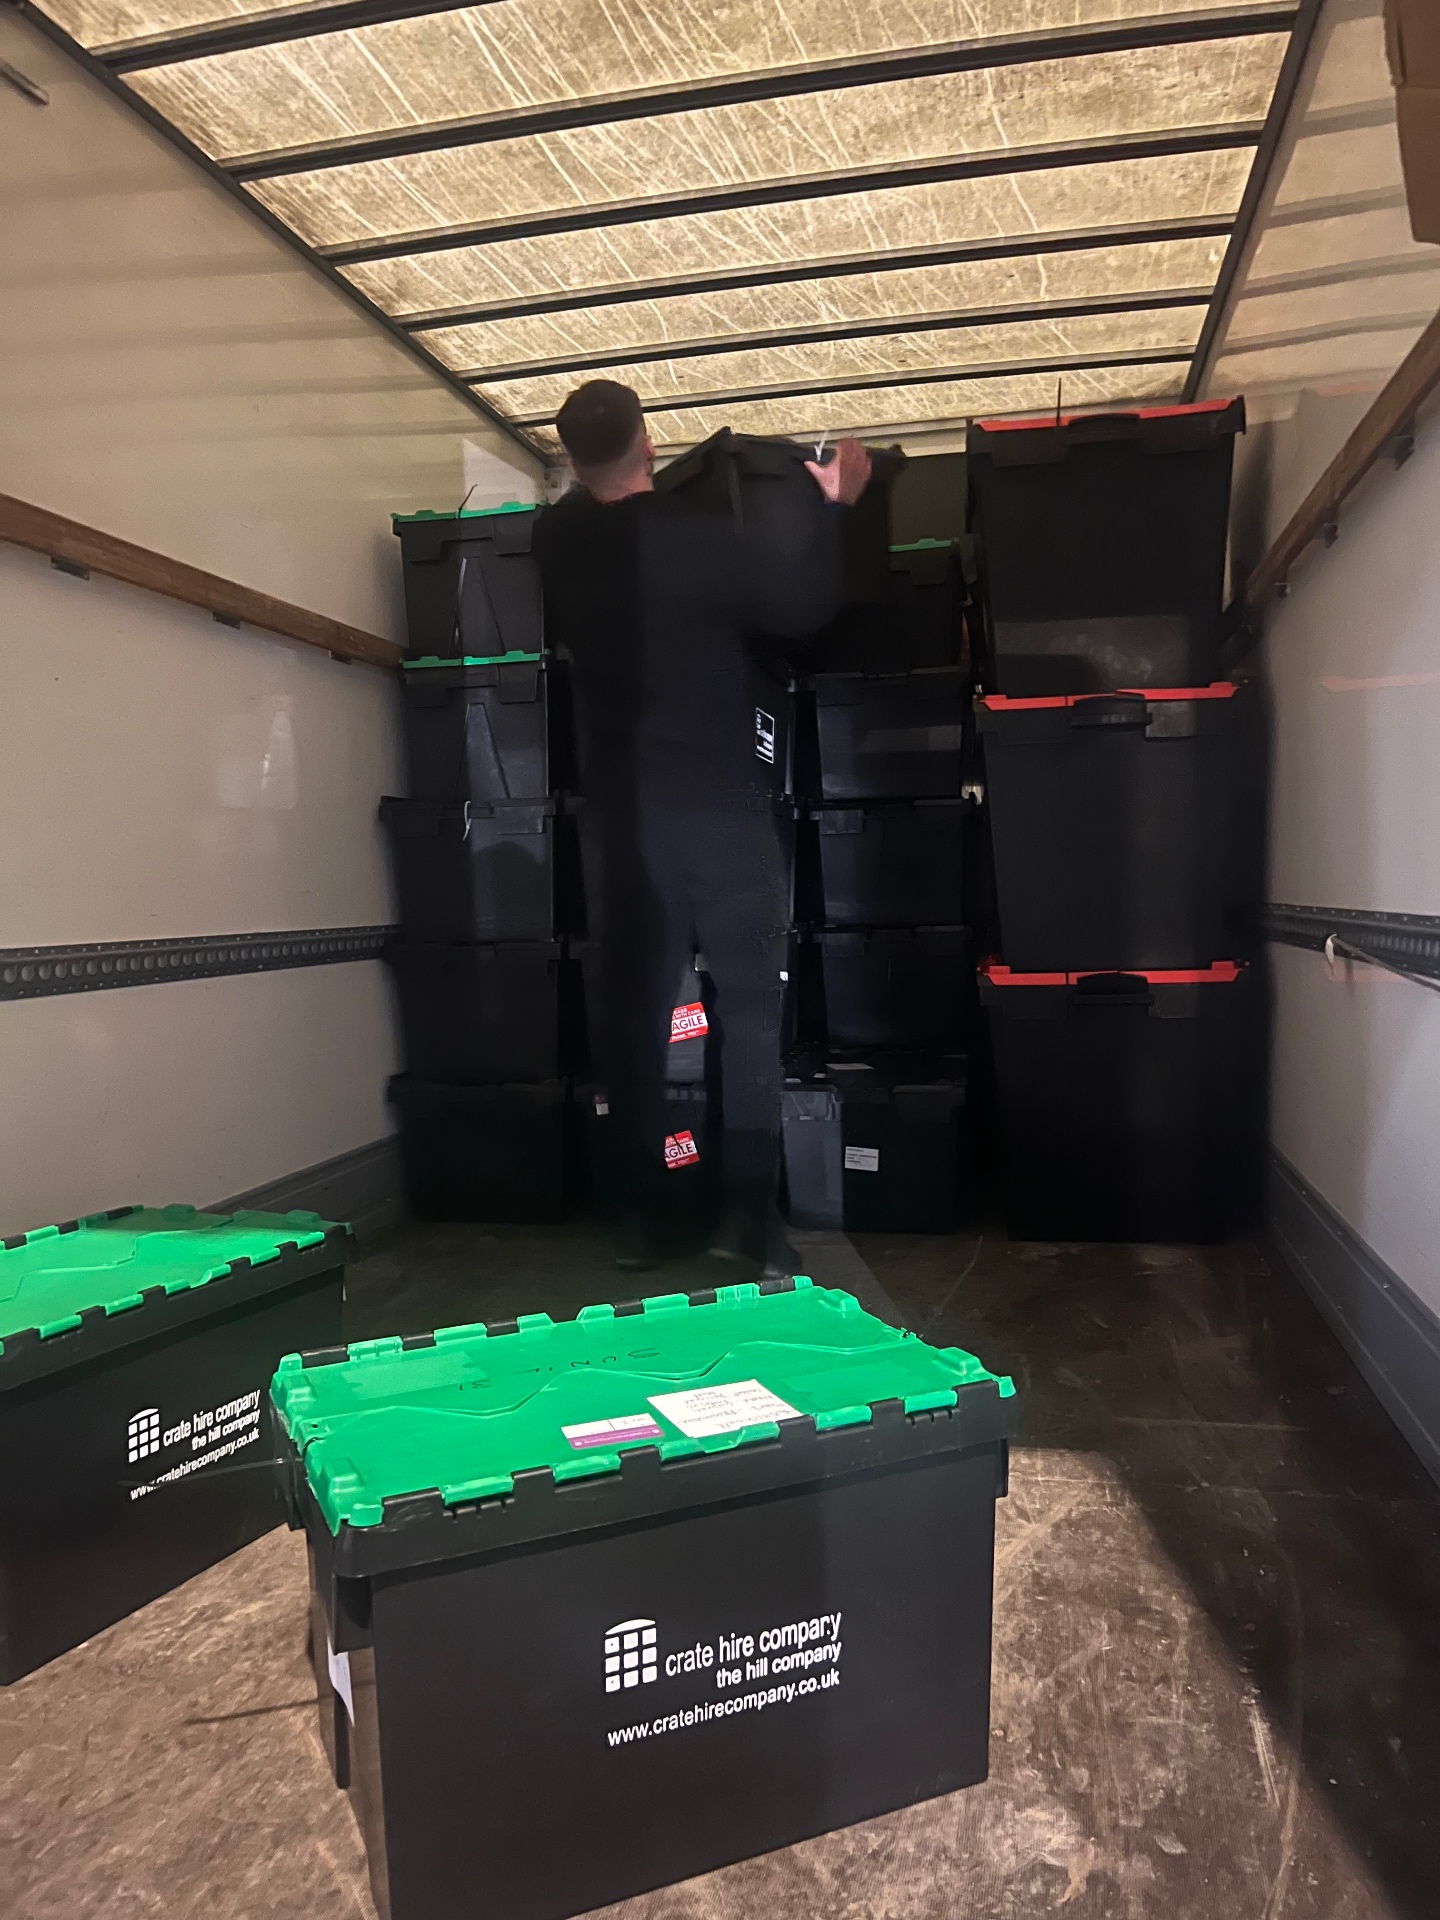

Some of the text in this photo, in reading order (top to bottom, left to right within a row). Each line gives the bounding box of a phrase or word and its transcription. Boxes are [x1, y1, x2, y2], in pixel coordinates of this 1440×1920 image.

[163, 1389, 261, 1447] crate hire company
[191, 1409, 260, 1451] the hill company
[665, 1611, 842, 1677] crate hire company
[716, 1641, 842, 1688] the hill company
[607, 1668, 840, 1747] www.cratehirecompany.co.uk
